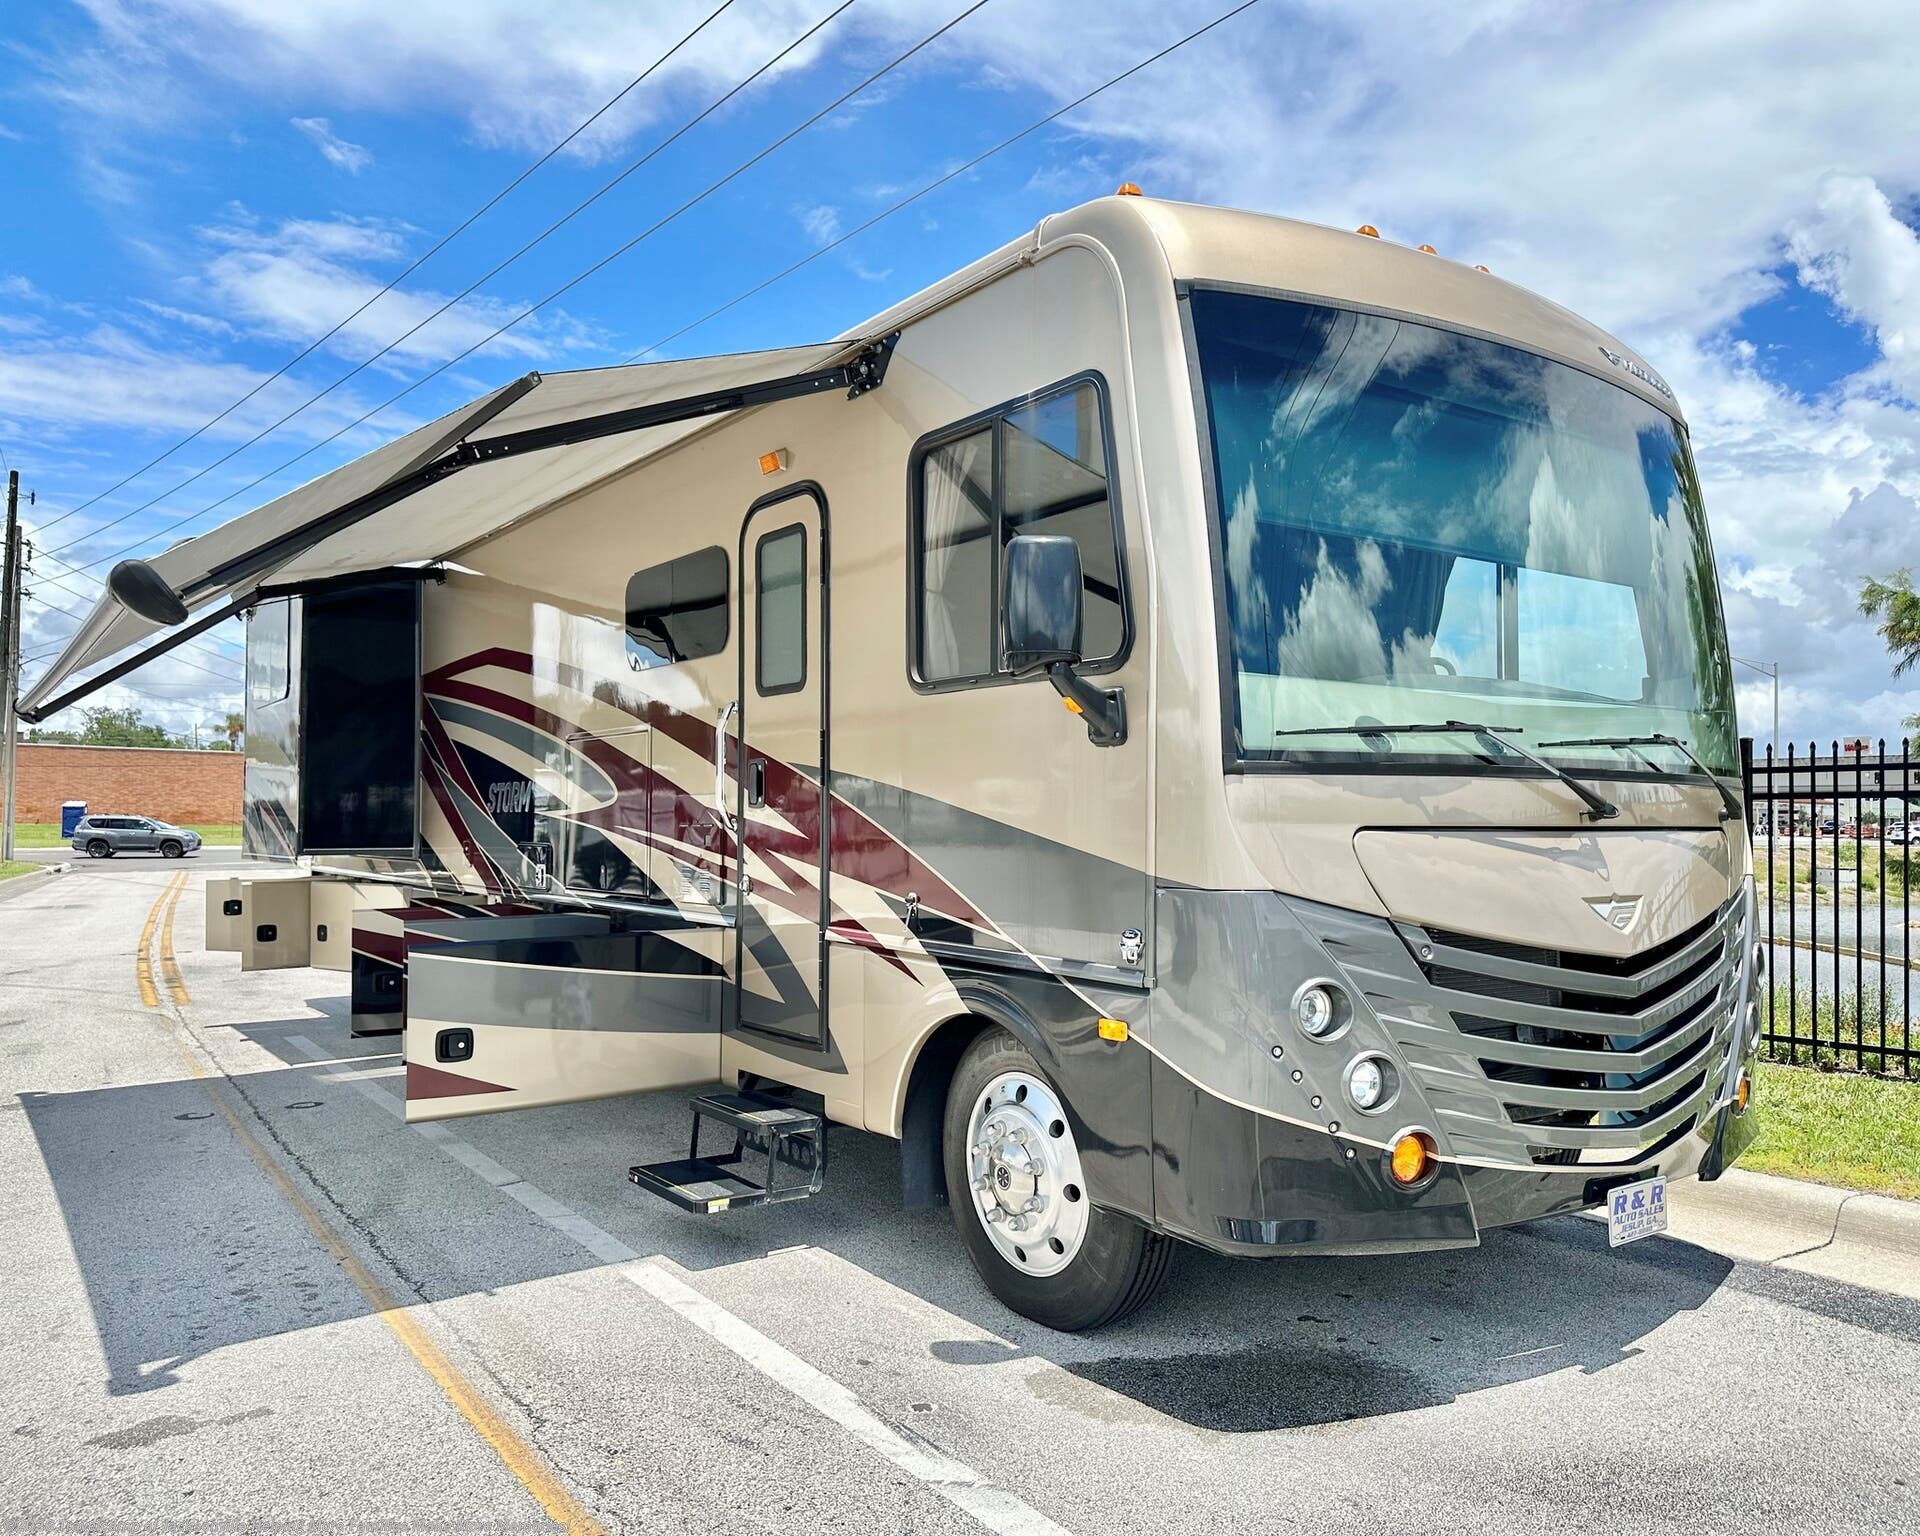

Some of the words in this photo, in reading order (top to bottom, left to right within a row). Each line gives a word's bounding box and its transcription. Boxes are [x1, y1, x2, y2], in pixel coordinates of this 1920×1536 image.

[487, 781, 533, 813] STORM
[1613, 1194, 1627, 1215] R
[1631, 1190, 1645, 1210] &
[1651, 1184, 1663, 1205] R
[1614, 1212, 1637, 1225] AUTO
[1638, 1204, 1664, 1219] SALES
